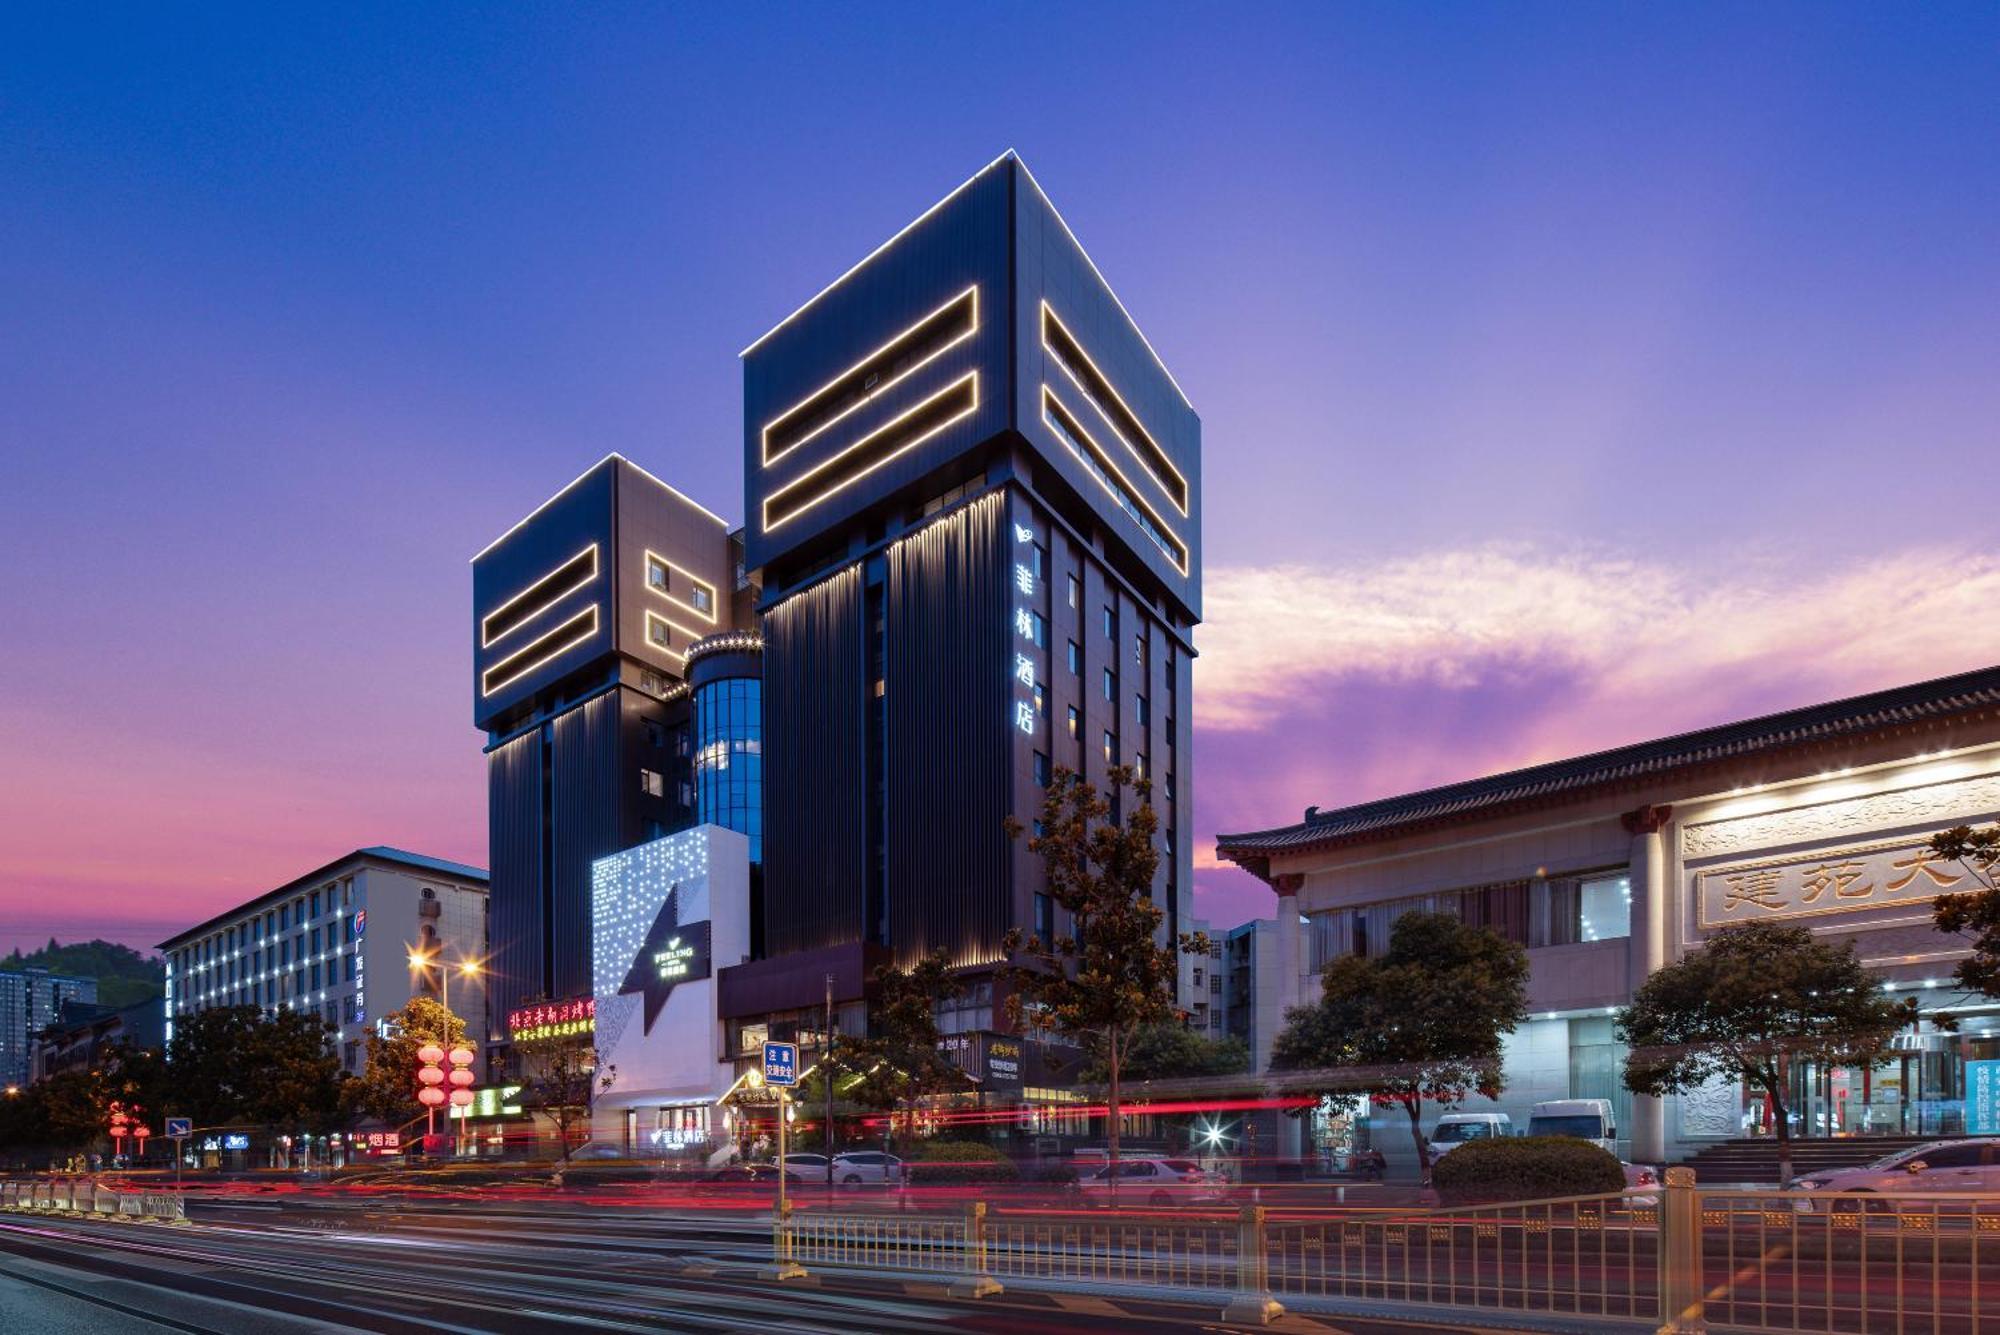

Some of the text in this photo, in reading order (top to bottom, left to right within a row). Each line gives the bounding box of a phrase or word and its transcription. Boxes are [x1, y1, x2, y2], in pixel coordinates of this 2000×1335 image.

[1015, 563, 1034, 735] 菲林酒店
[1723, 849, 2000, 912] 建苑大
[369, 1133, 399, 1146] 烟酒
